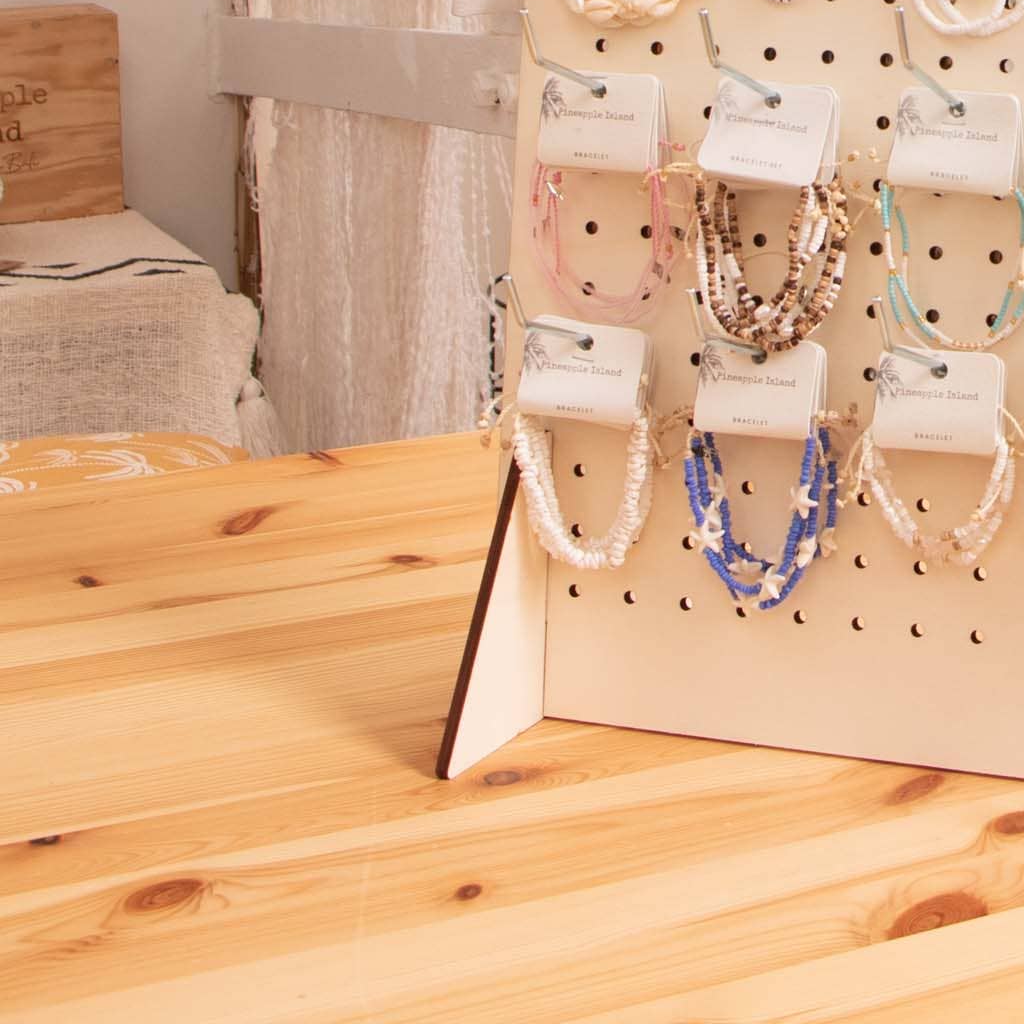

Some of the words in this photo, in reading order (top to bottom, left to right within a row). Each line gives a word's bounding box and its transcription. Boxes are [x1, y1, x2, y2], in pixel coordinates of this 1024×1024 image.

[559, 107, 602, 120] Pineapple
[605, 111, 634, 121] Island
[966, 130, 998, 142] Island
[541, 359, 588, 373] Pineapple
[591, 364, 622, 377] Island
[717, 371, 763, 385] Pineapple
[765, 375, 797, 388] Island
[895, 387, 944, 400] Pineapple
[946, 389, 979, 401] Island
